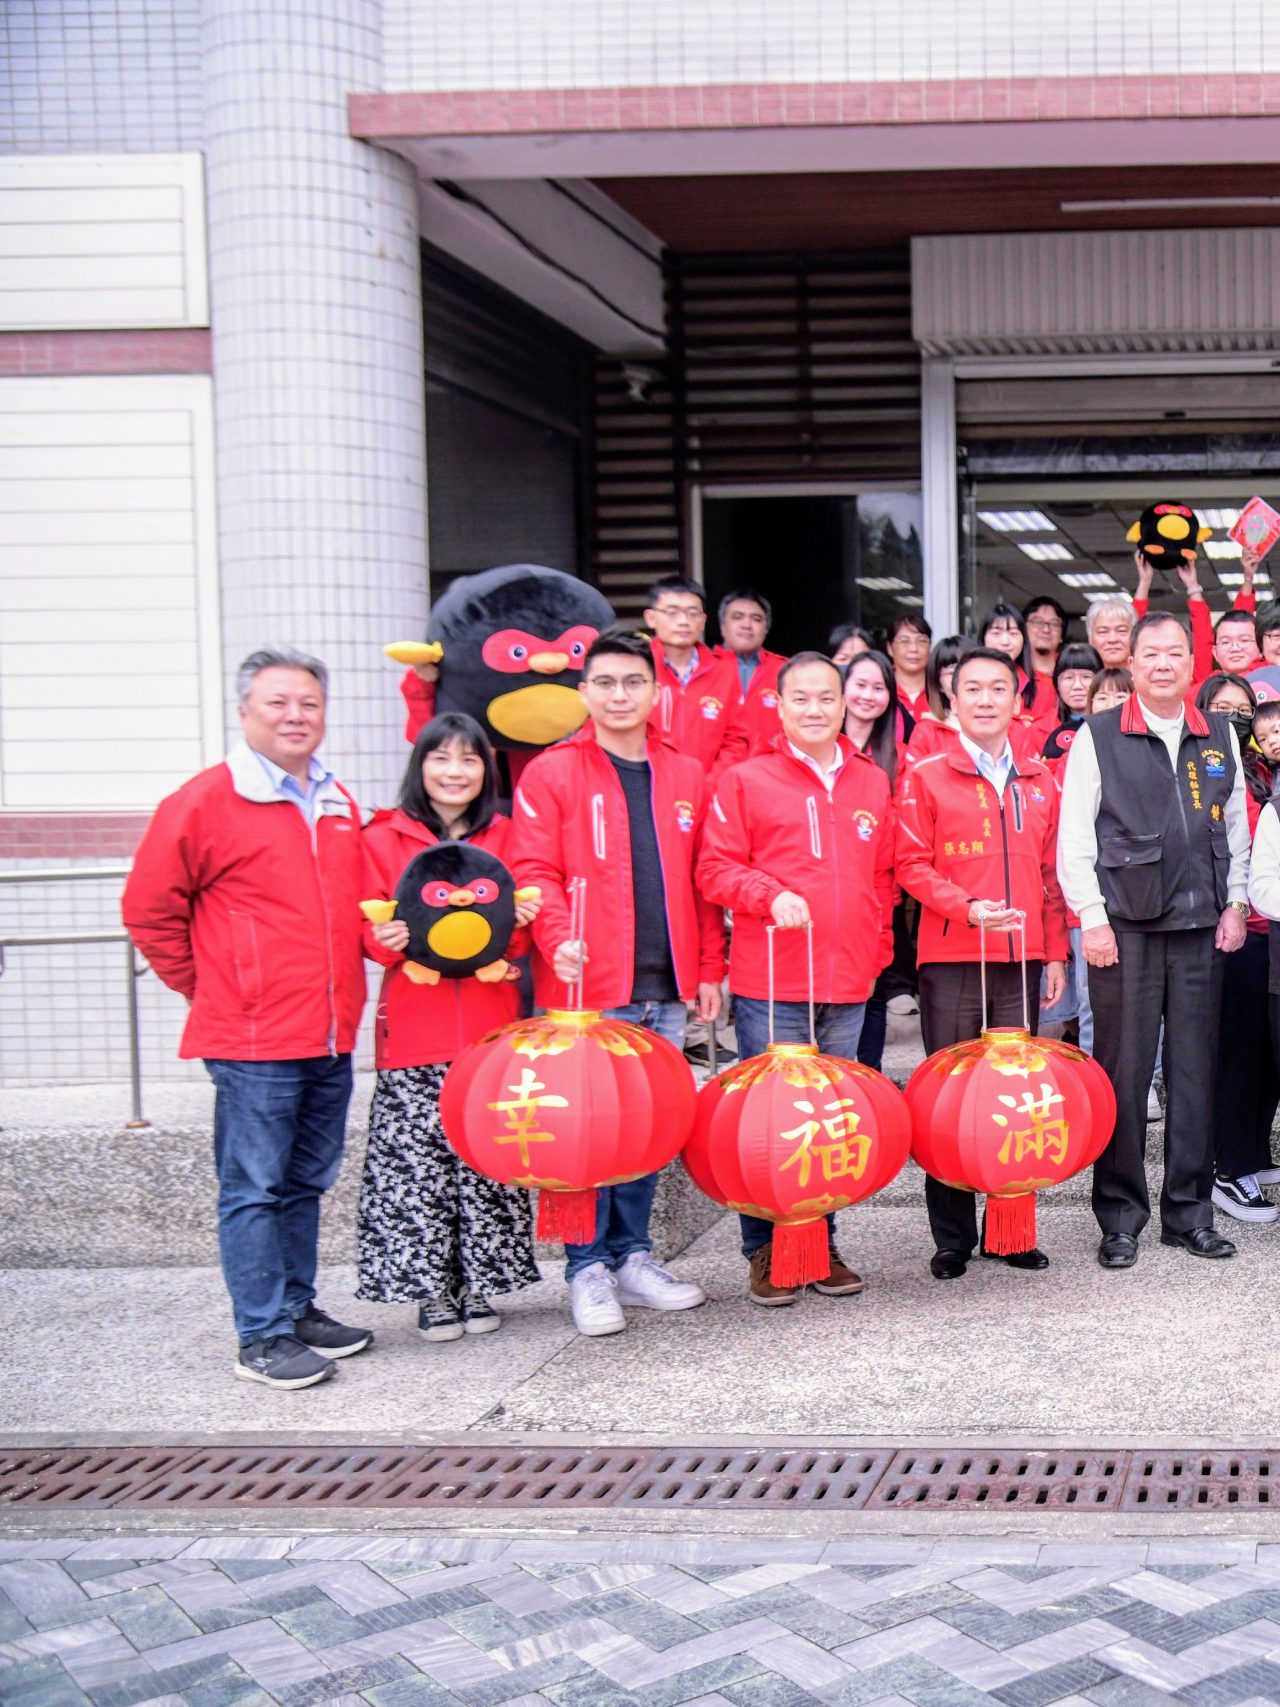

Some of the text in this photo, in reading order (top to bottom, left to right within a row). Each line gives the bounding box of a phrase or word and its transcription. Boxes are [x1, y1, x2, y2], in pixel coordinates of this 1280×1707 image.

[487, 1068, 569, 1168] 幸
[778, 1098, 873, 1188] 福
[991, 1083, 1069, 1166] 滿
